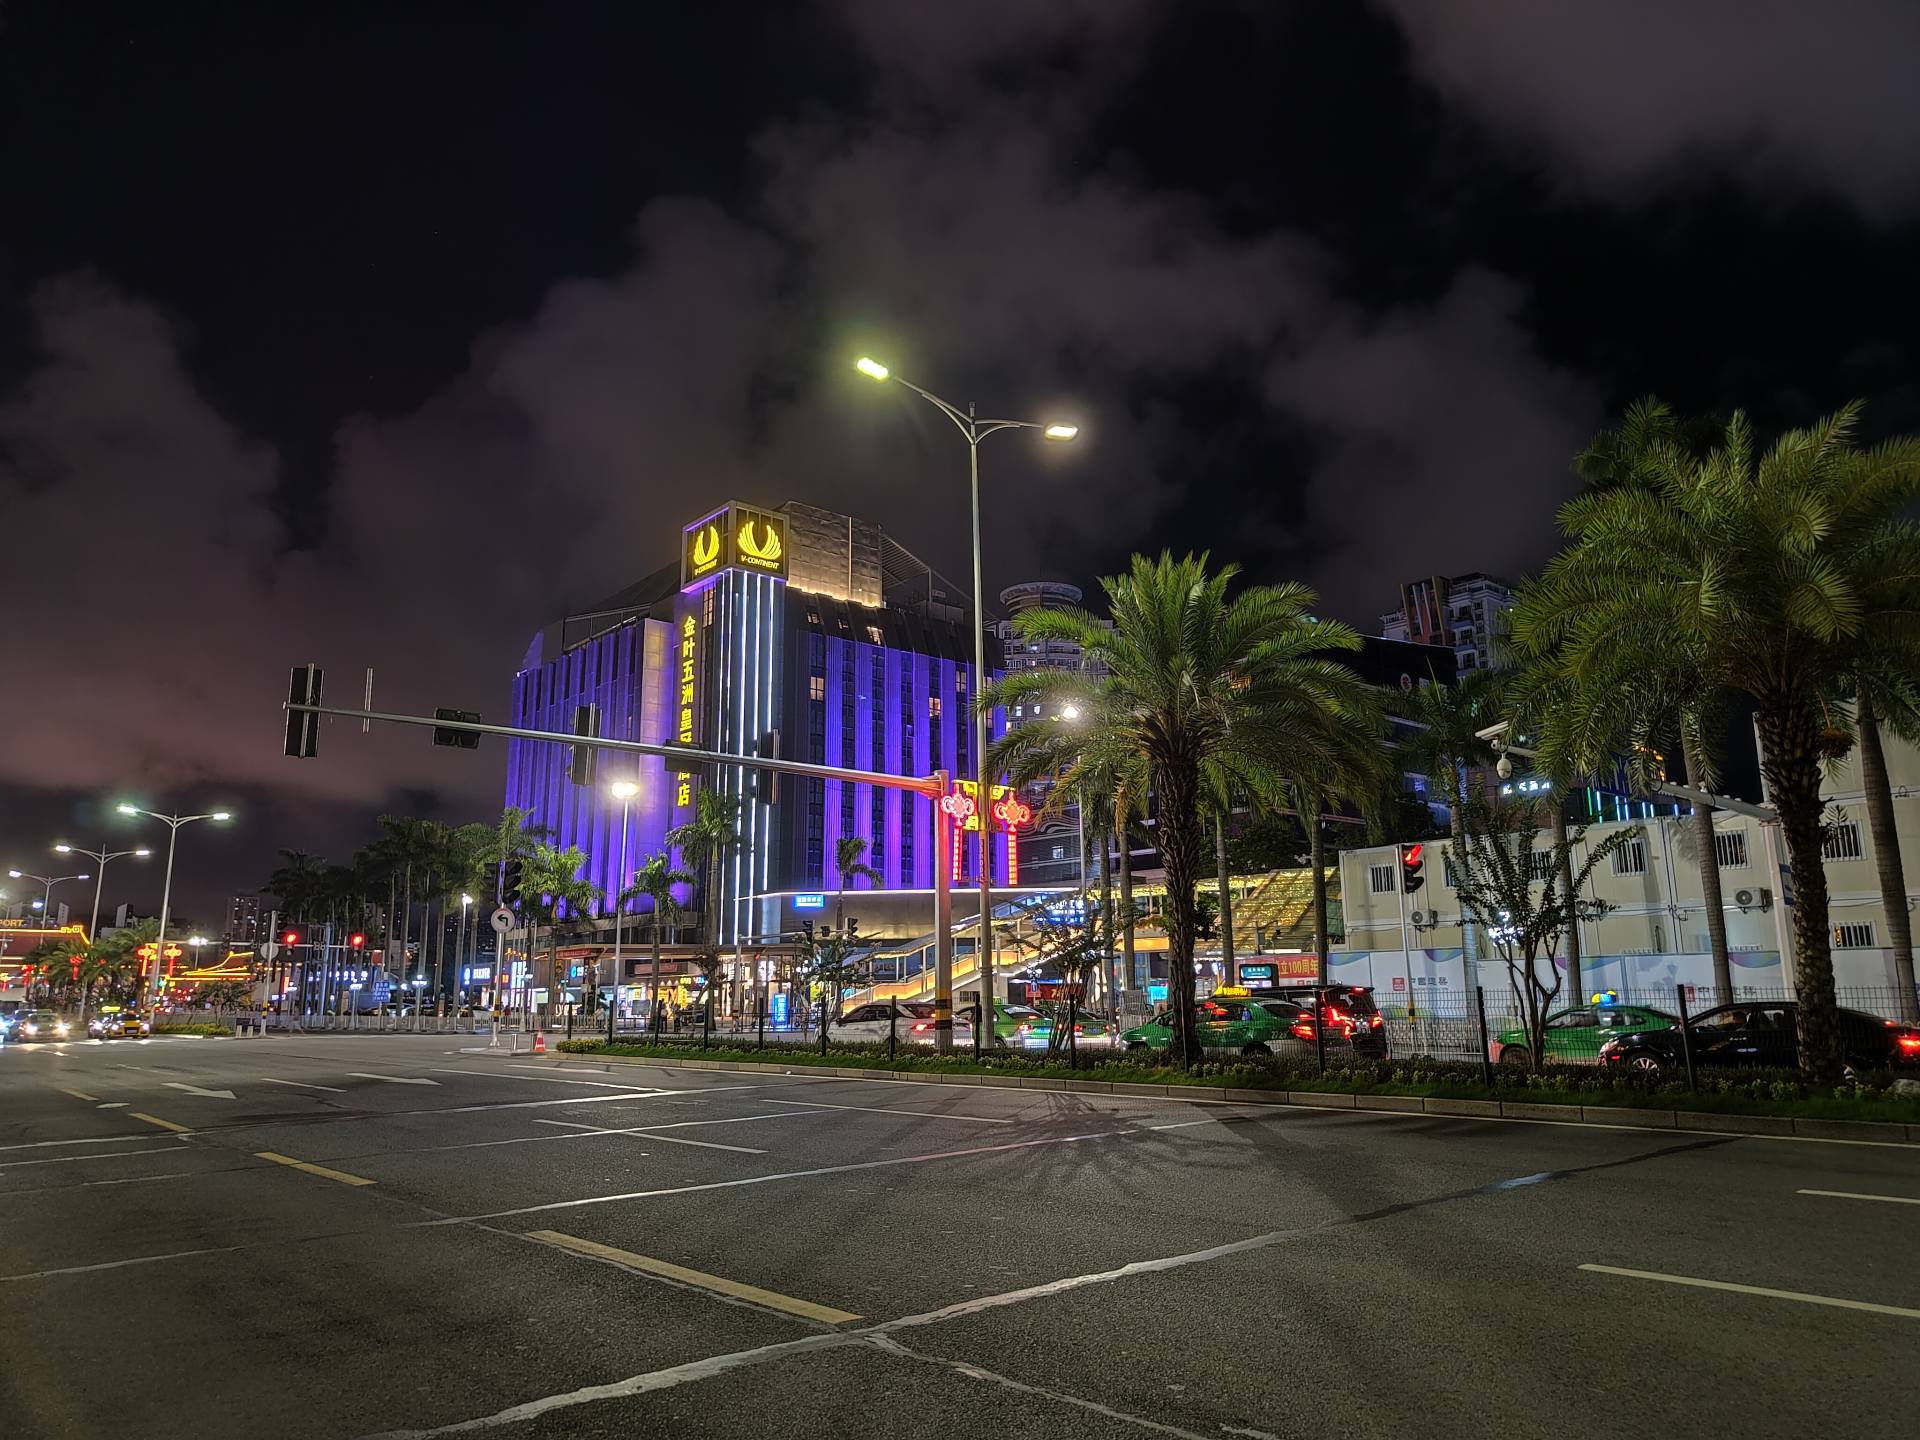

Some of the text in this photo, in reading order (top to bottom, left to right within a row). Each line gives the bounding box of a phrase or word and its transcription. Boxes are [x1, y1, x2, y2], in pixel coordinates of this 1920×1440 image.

[741, 555, 779, 569] V-CONTINENT
[1276, 958, 1318, 975] 立100周年
